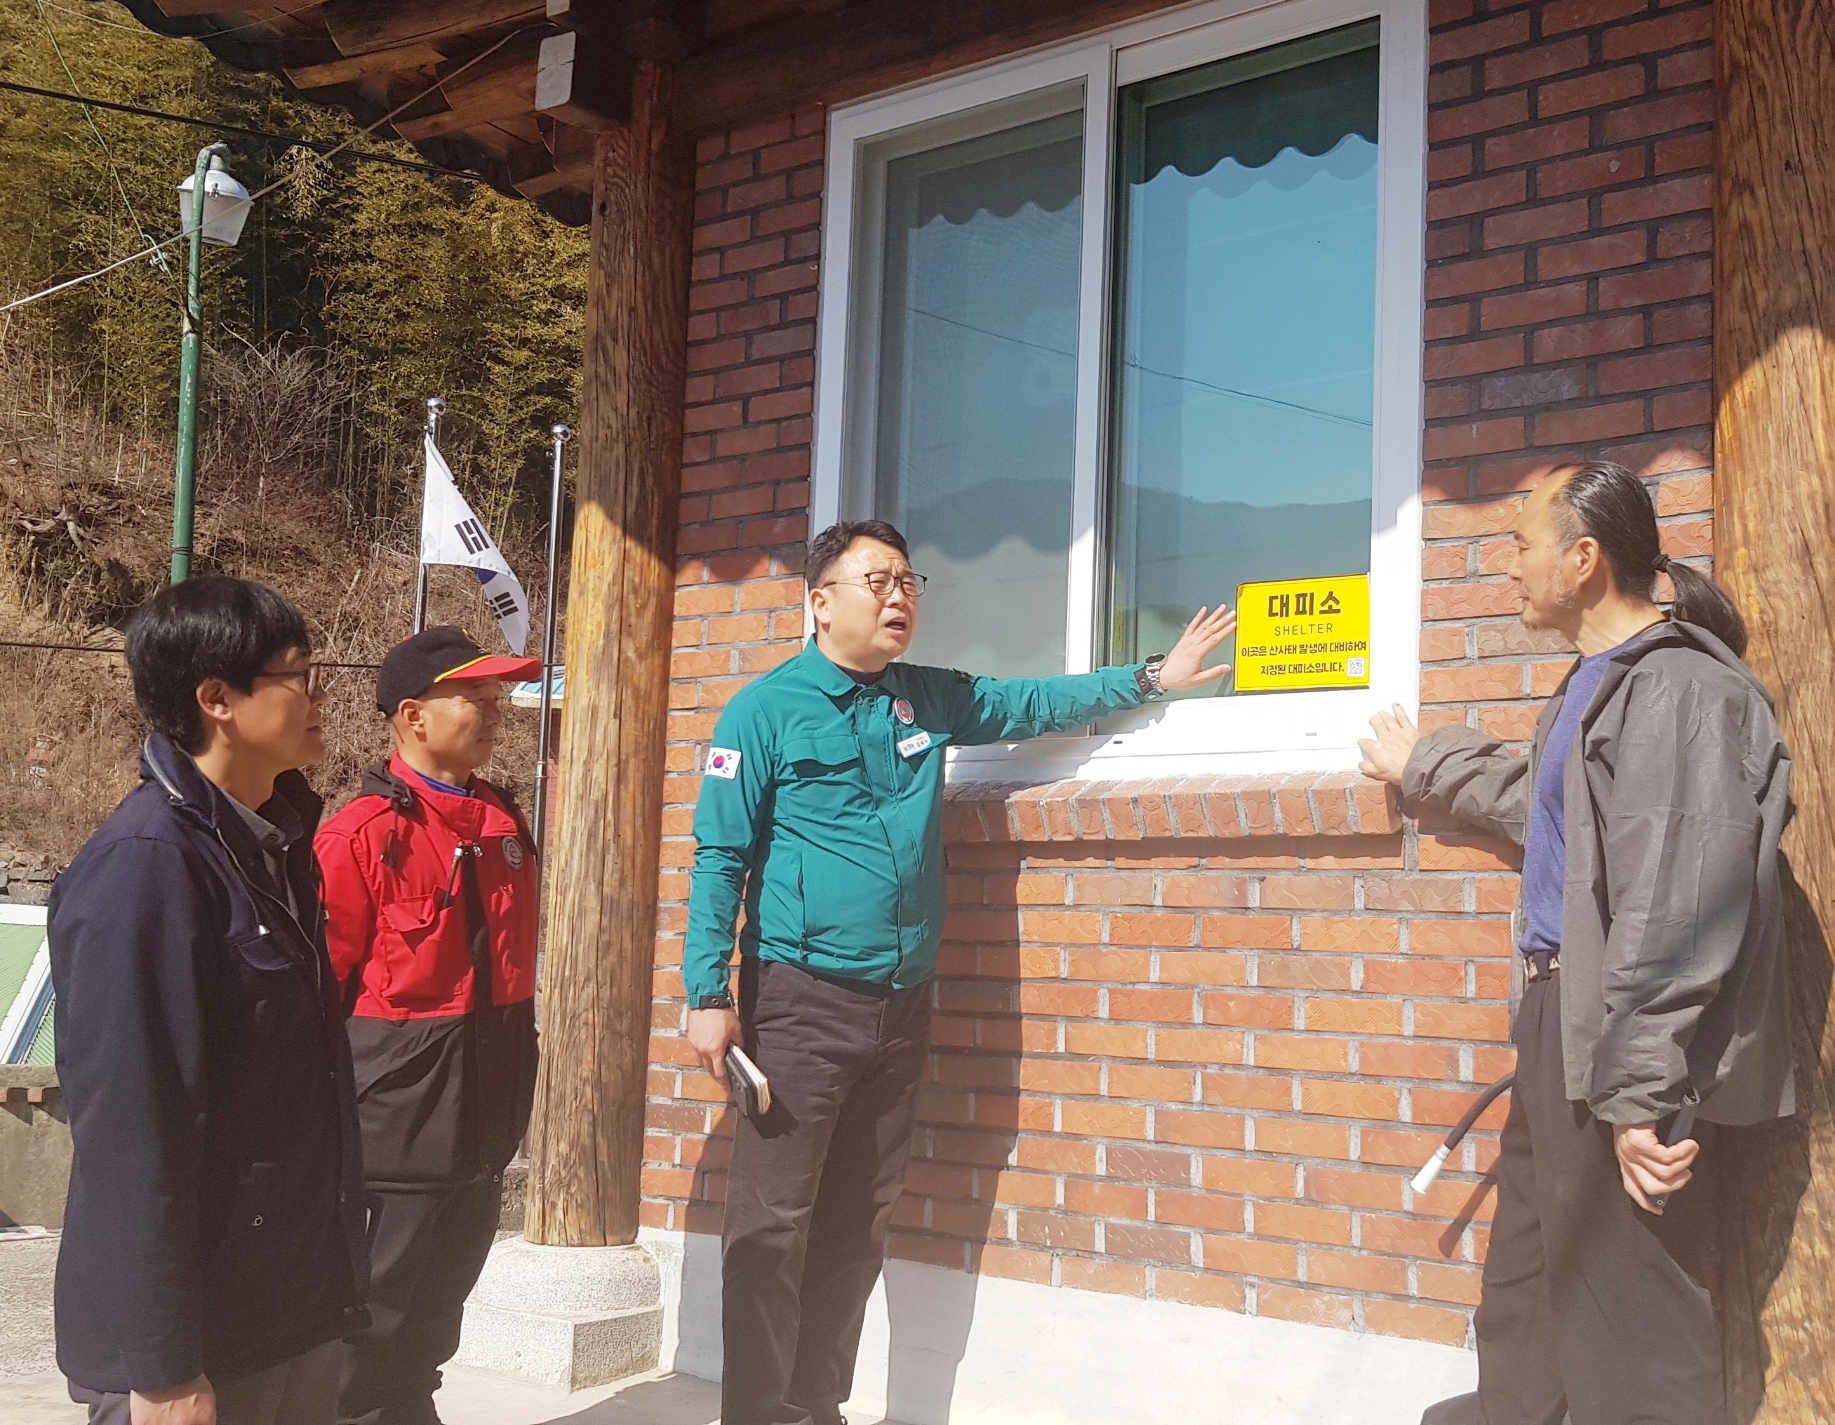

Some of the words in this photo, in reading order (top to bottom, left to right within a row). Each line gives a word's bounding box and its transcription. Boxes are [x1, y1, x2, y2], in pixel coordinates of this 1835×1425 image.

[1268, 591, 1341, 618] 대피소
[1274, 623, 1333, 637] SHELTER
[1241, 645, 1267, 657] 이곳은
[1269, 644, 1297, 656] 산사태
[1299, 643, 1327, 654] 발생에
[1329, 640, 1367, 653] 대비하여
[1260, 663, 1286, 676] 지정된
[1288, 661, 1345, 675] 대피소입니다.
